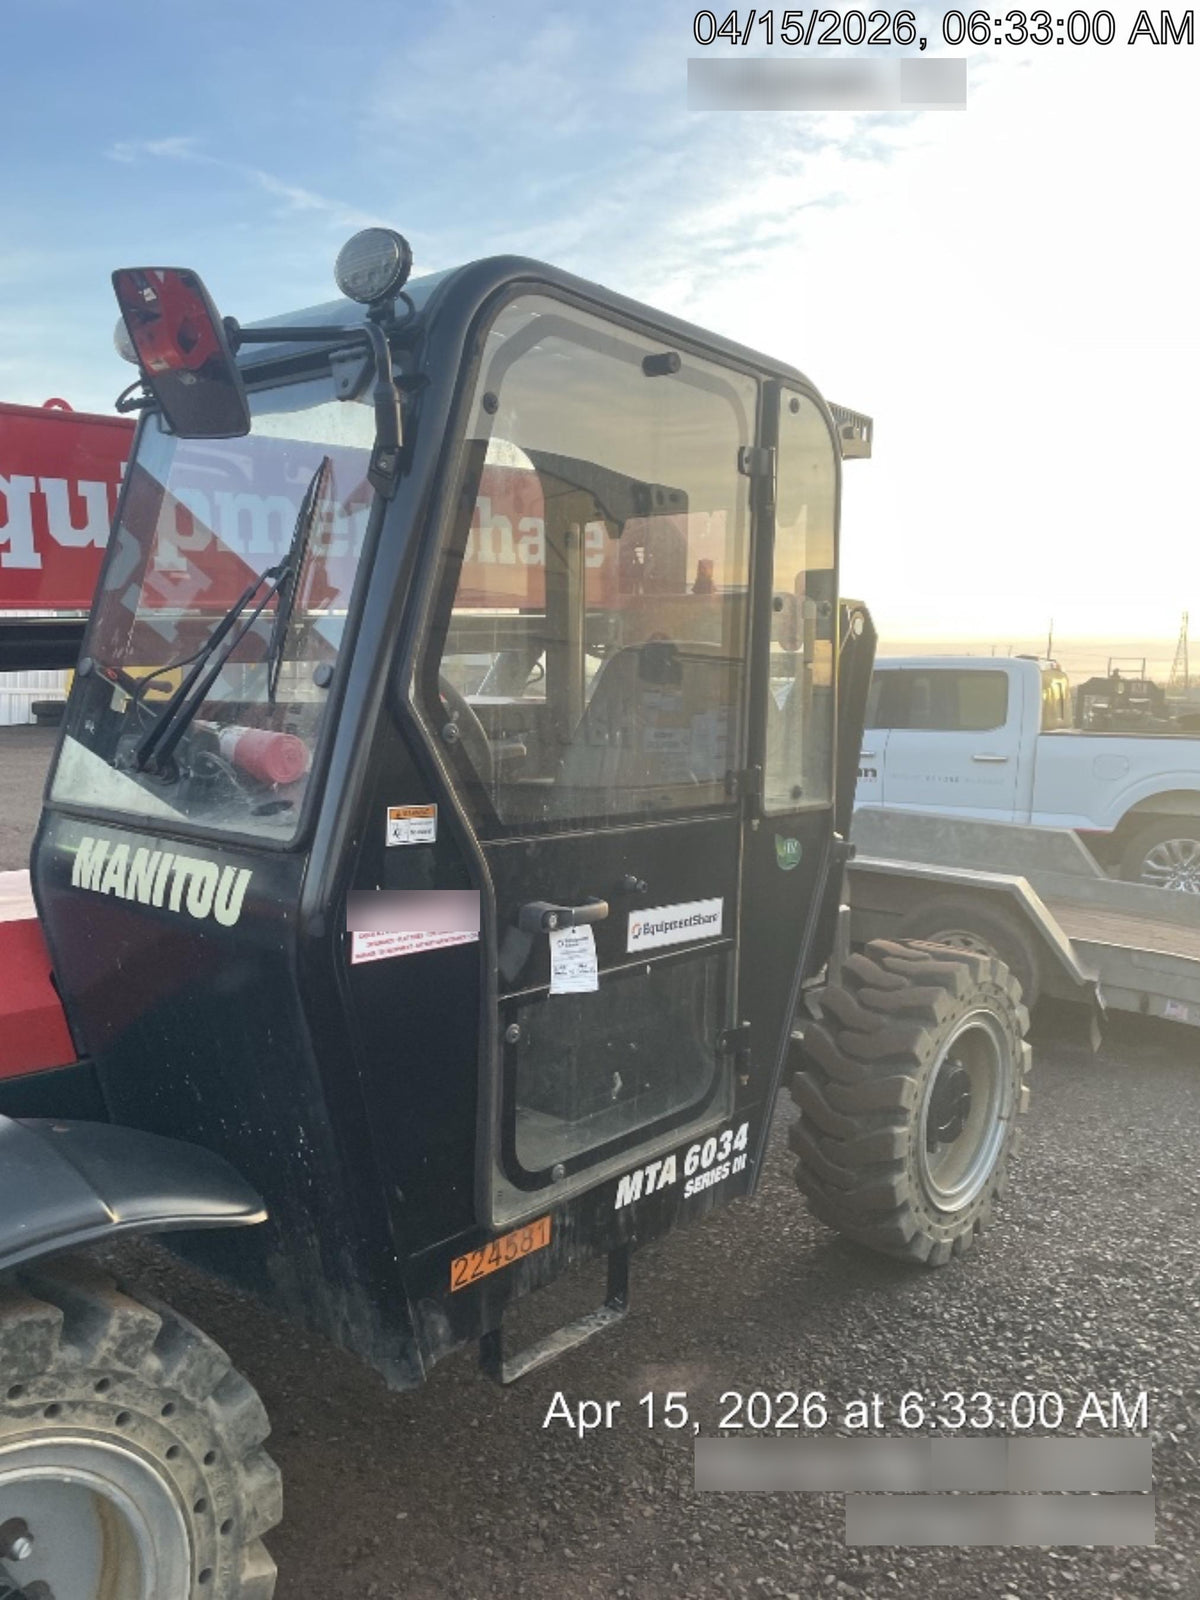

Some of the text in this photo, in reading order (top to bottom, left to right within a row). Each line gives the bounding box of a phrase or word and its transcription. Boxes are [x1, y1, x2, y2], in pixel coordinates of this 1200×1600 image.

[72, 837, 253, 927] MANITOU
[614, 1121, 749, 1210] MTA 6034
[683, 1161, 732, 1199] SERIES
[454, 1219, 546, 1286] 224581
